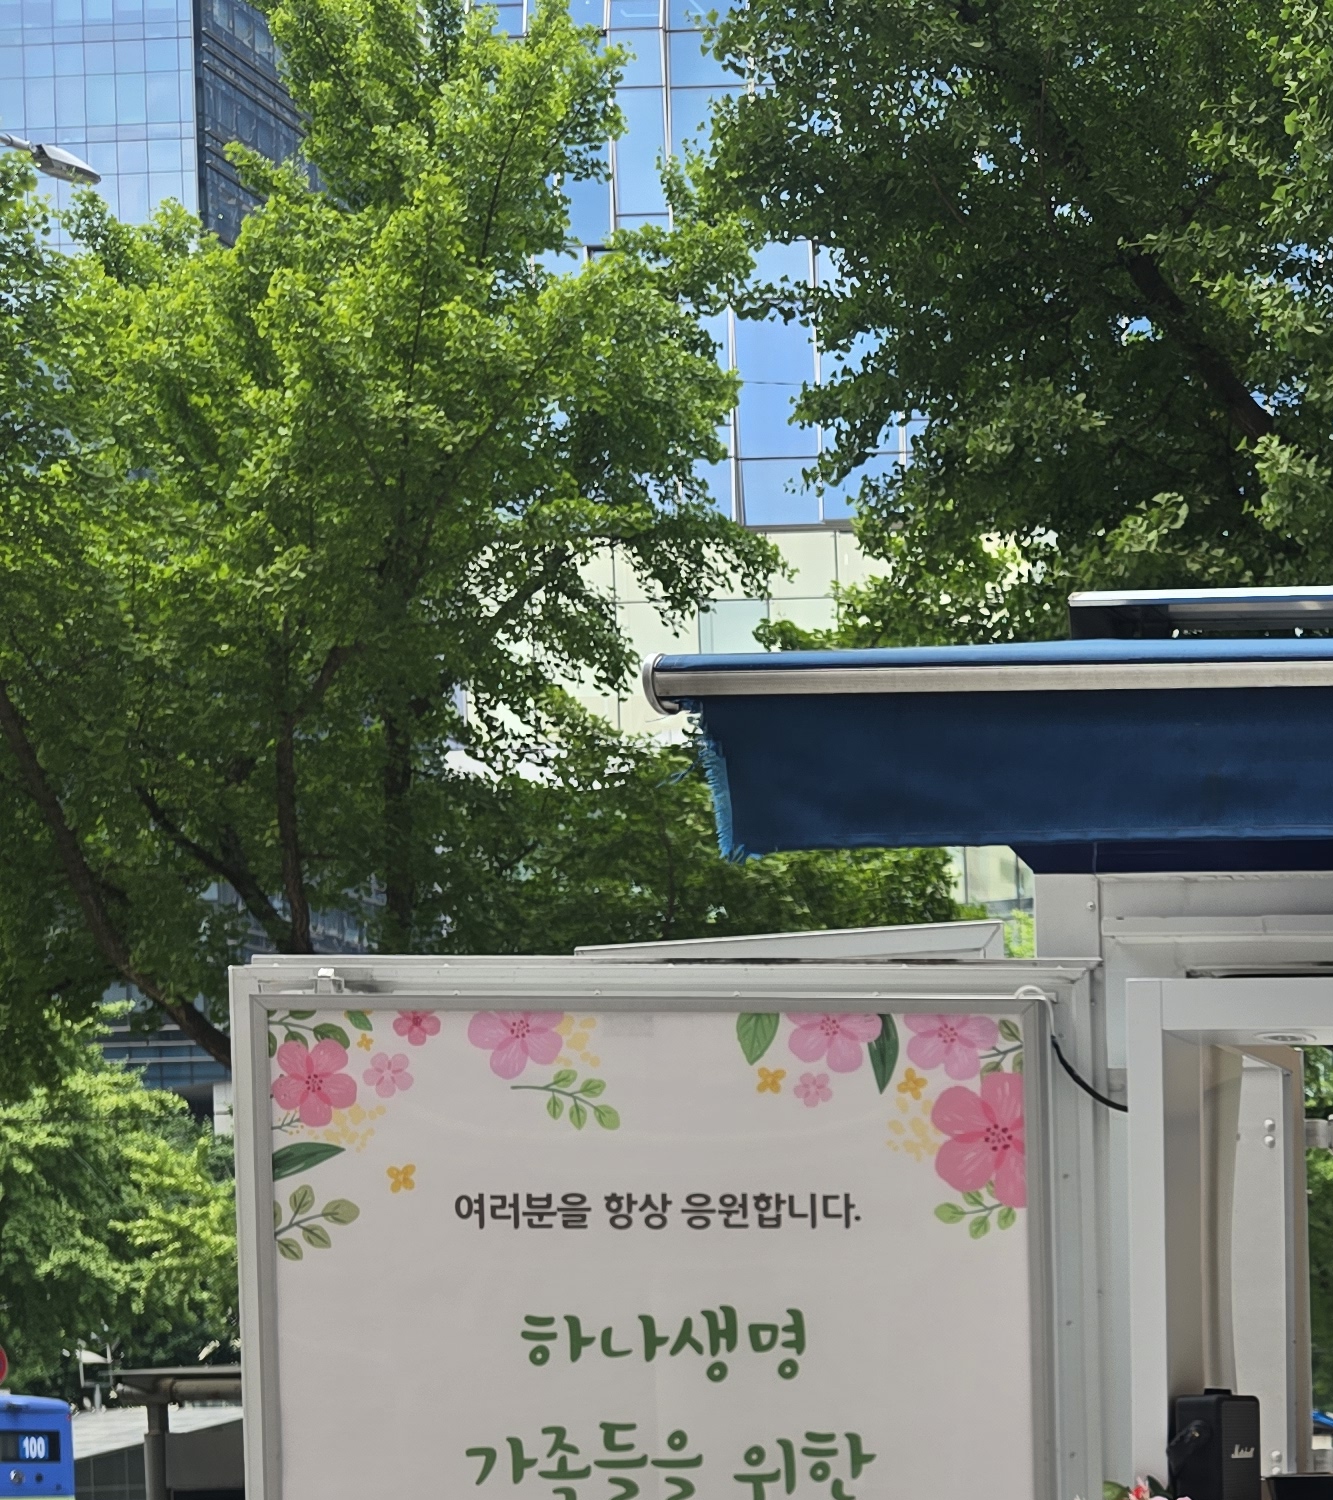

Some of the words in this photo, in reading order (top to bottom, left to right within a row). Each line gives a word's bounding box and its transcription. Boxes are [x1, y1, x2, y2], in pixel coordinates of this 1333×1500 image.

[454, 1193, 592, 1229] 여러분을
[603, 1193, 672, 1230] 항상
[680, 1193, 862, 1230] 응원합니다.
[520, 1304, 807, 1383] 하나생명
[23, 1436, 46, 1459] 100
